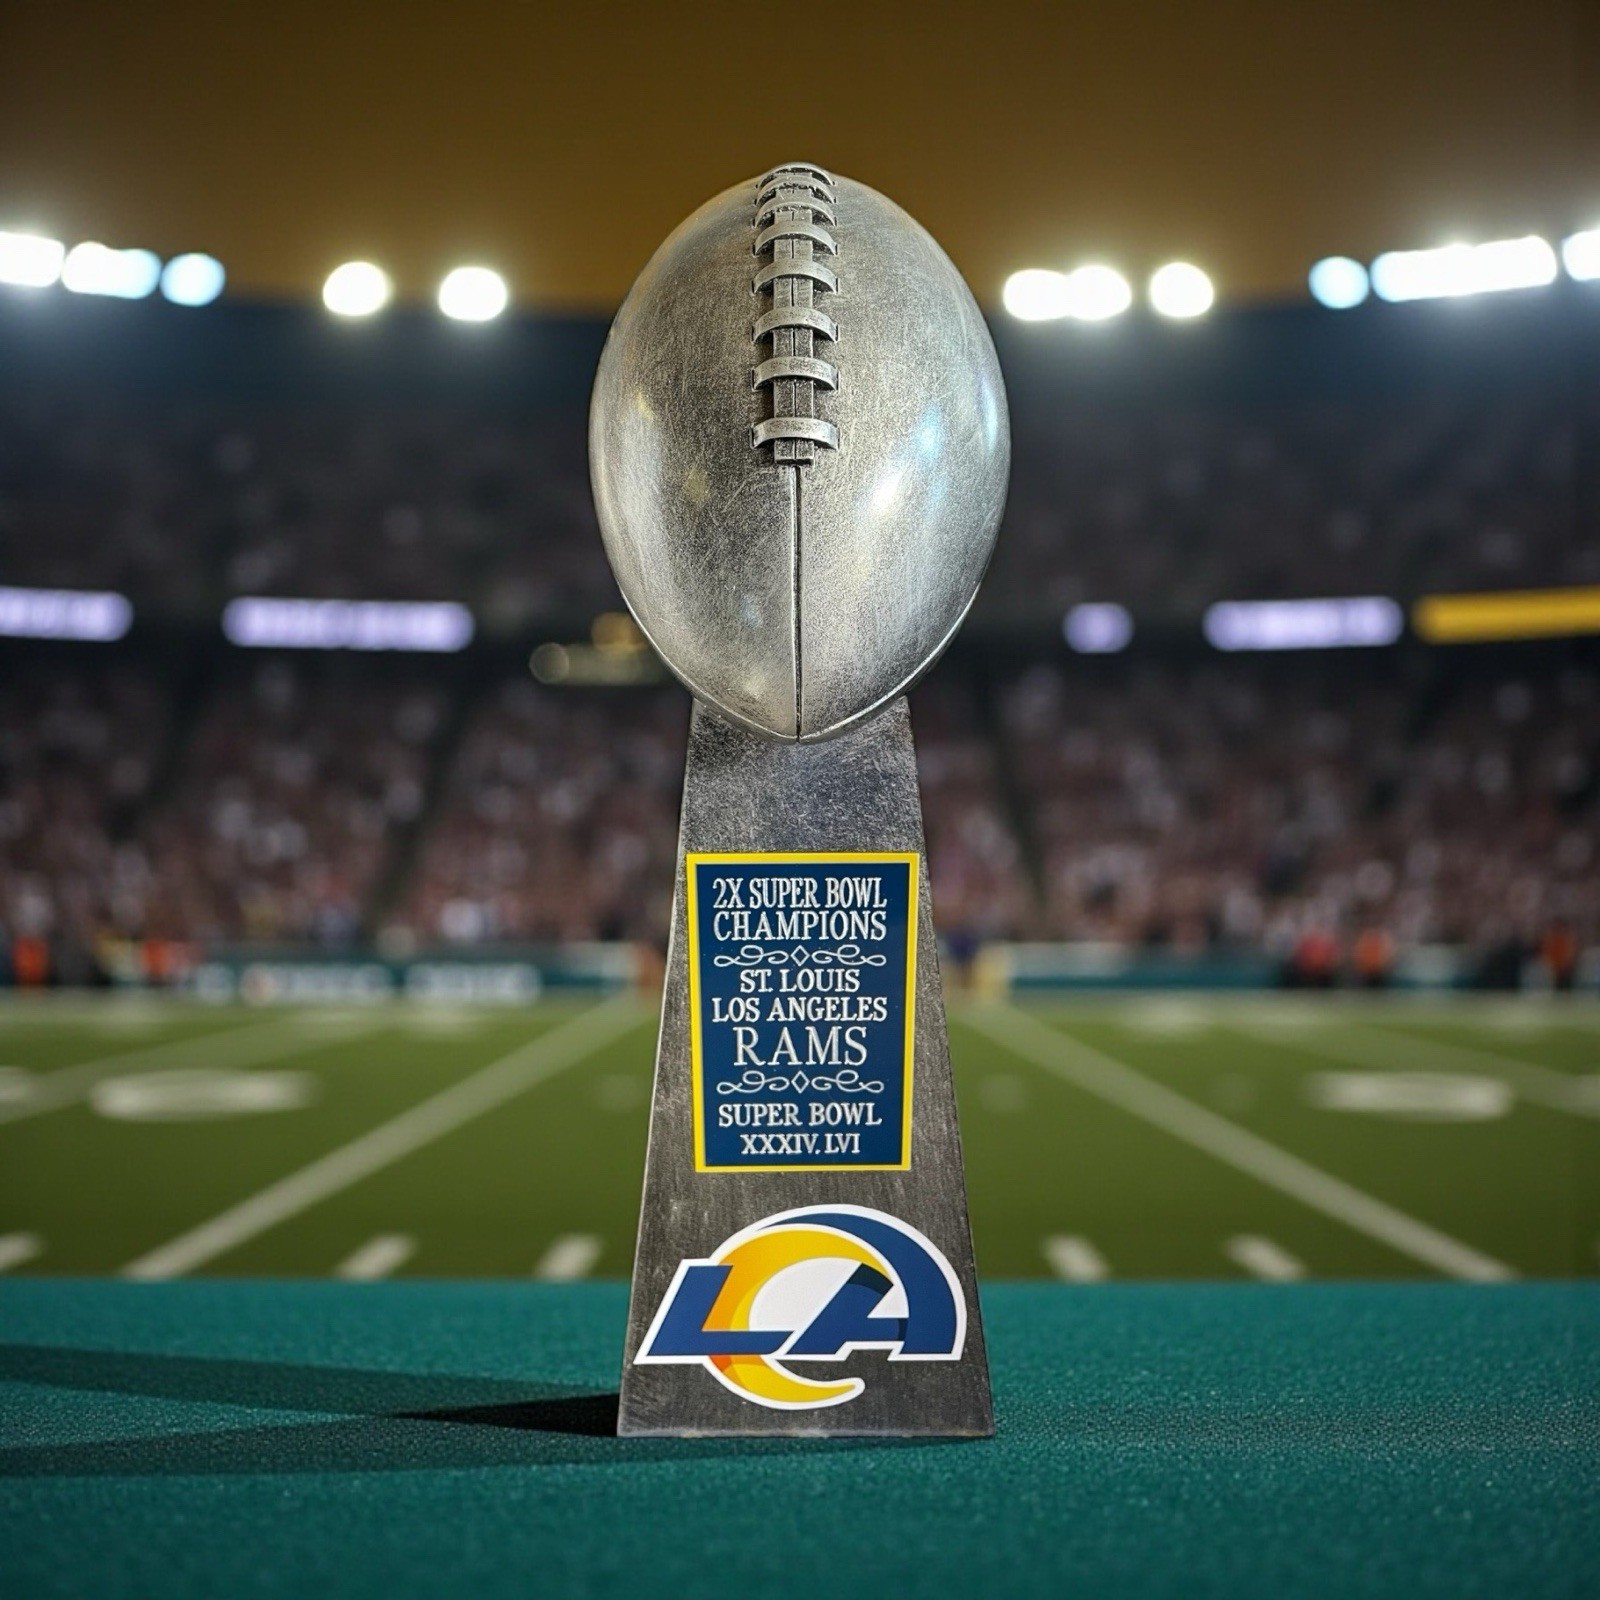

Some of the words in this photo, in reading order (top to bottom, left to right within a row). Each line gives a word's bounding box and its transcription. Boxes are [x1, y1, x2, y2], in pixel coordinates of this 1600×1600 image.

[712, 877, 745, 909] 2X
[749, 877, 821, 909] SUPER
[824, 877, 888, 909] BOWL
[713, 910, 887, 941] CHAMPIONS
[779, 968, 860, 992] LOUIS
[711, 997, 761, 1022] LOS
[766, 997, 888, 1022] ANGELES
[732, 1025, 868, 1066] RAMS
[718, 1102, 803, 1127] SUPER
[808, 1102, 882, 1126] BOWL
[824, 1132, 861, 1154] LVI
